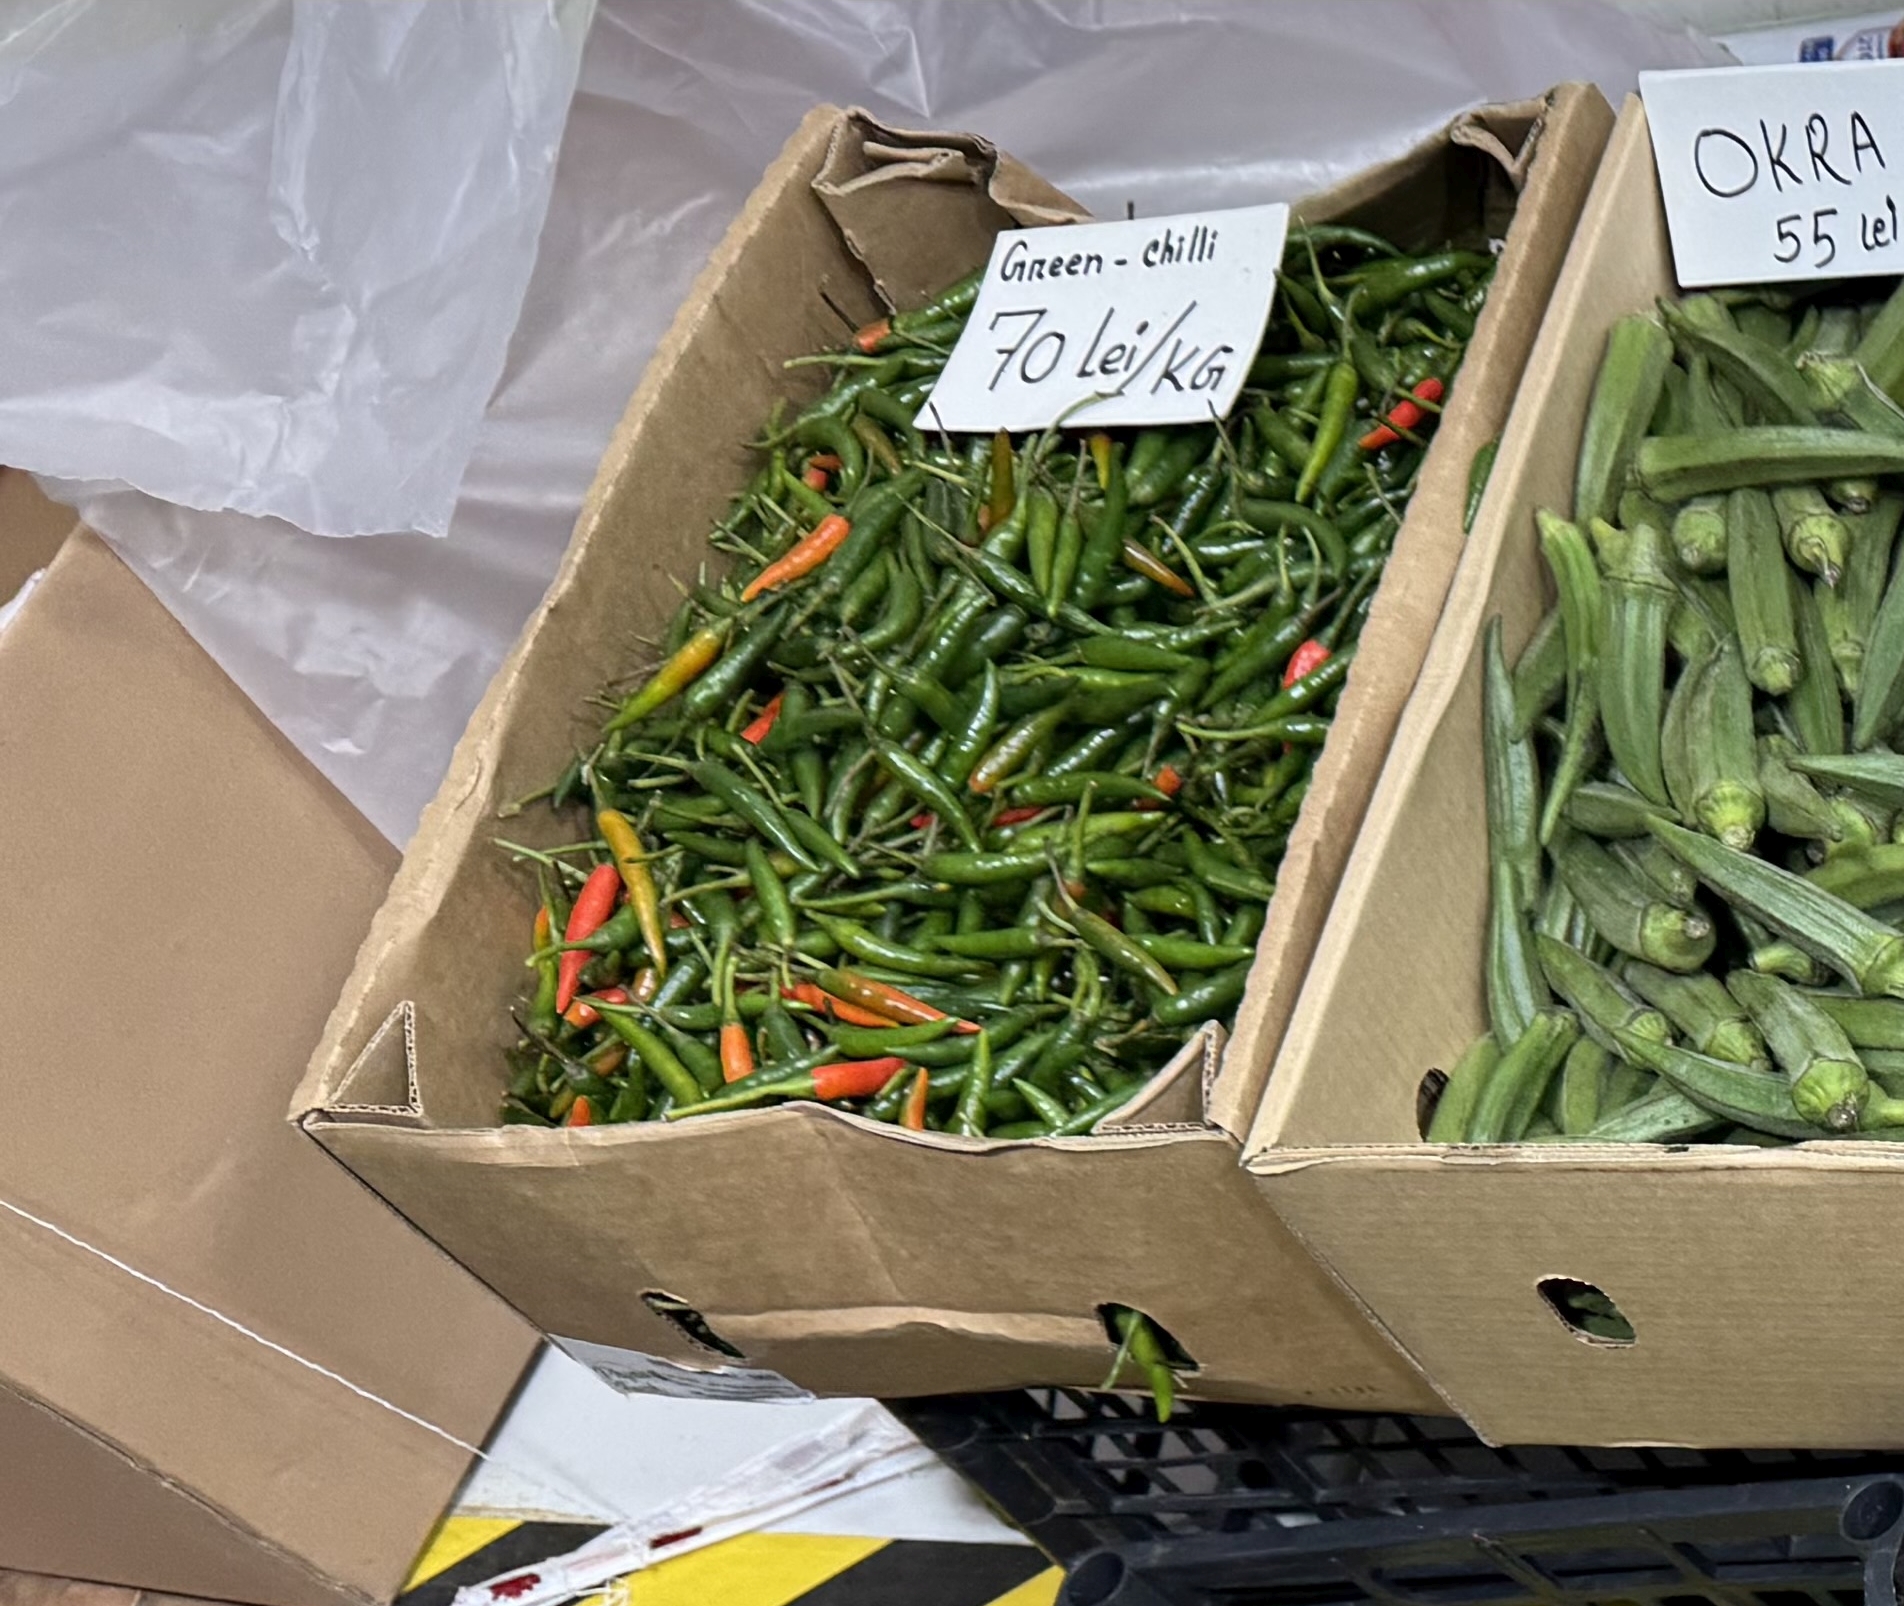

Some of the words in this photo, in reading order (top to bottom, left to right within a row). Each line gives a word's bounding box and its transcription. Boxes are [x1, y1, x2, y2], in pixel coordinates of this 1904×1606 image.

[1694, 111, 1886, 197] OKRA
[1000, 240, 1103, 281] Green
[1773, 208, 1838, 268] 55
[988, 308, 1066, 392] 70
